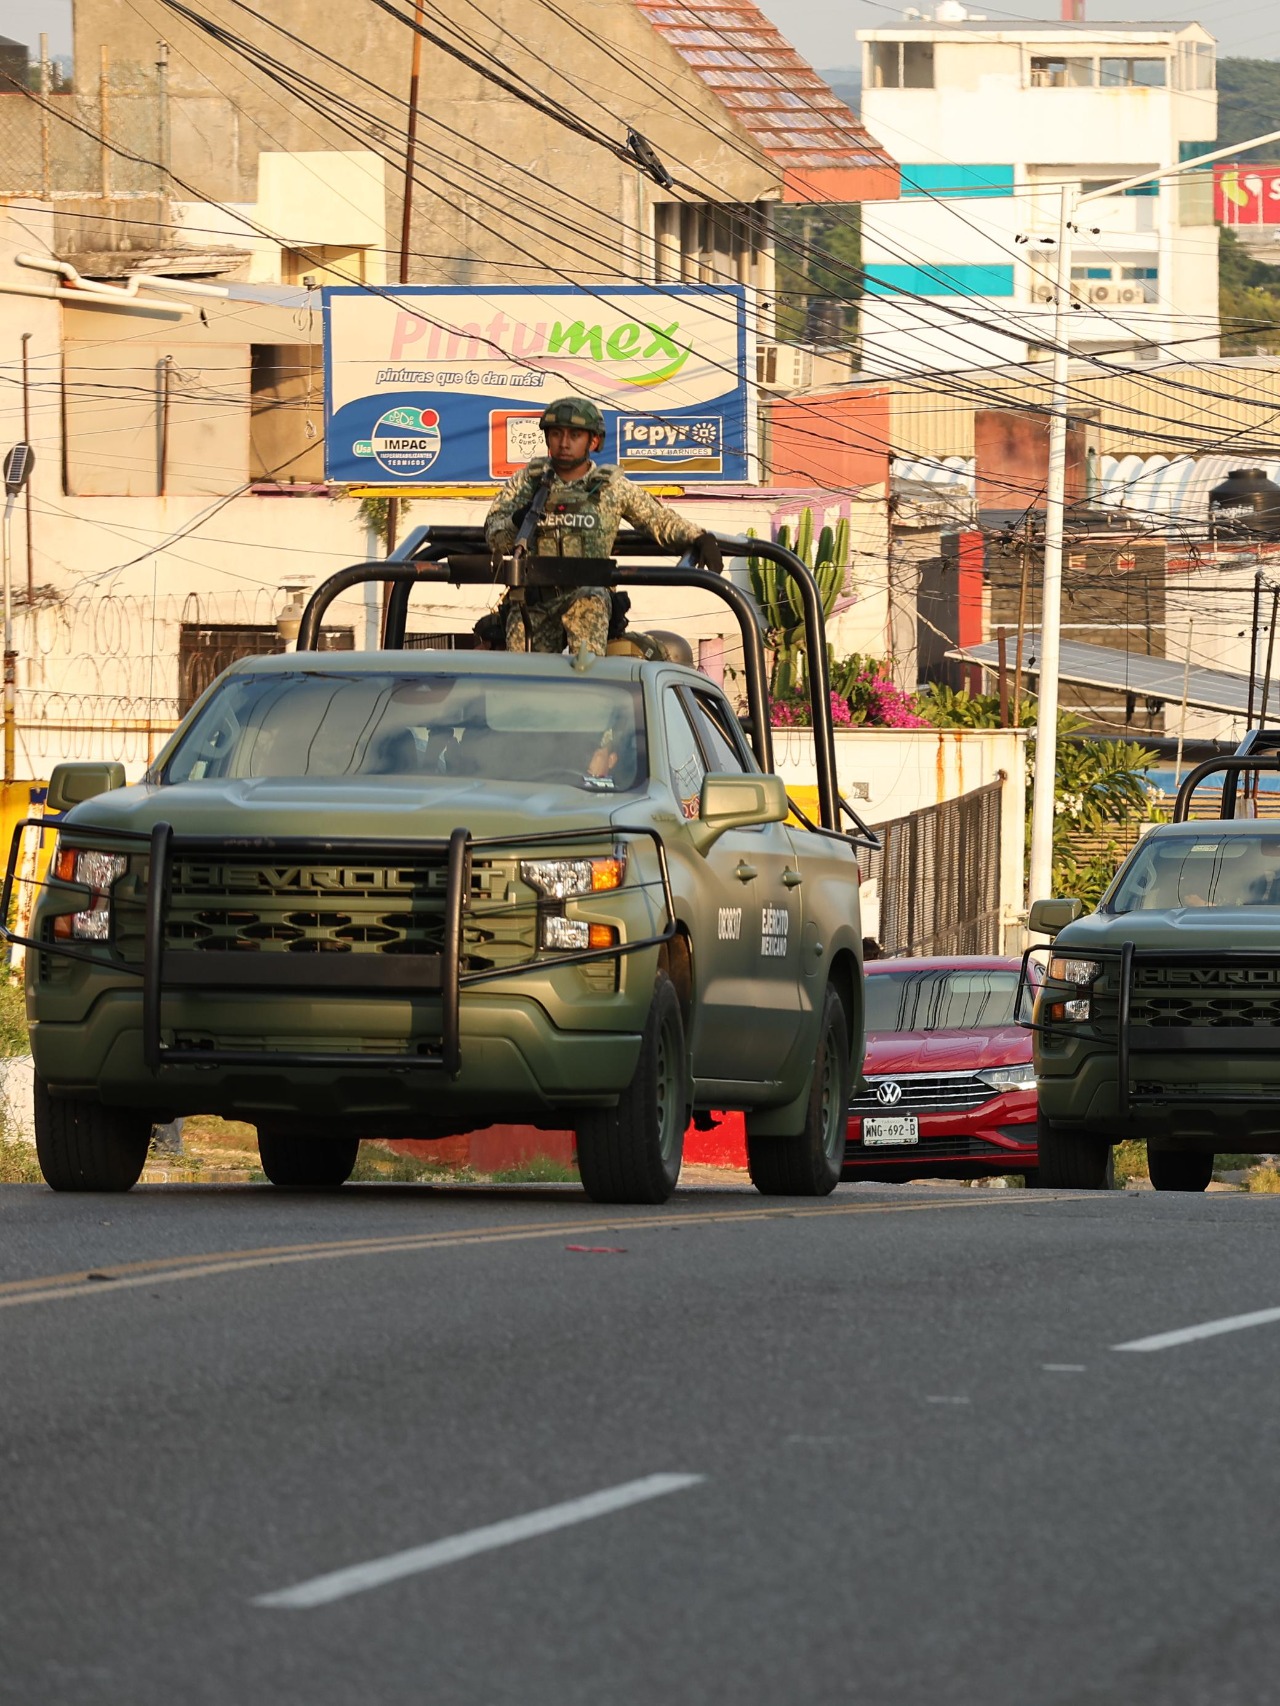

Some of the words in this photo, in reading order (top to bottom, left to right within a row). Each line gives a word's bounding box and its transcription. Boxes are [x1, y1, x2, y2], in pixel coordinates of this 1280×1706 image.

[389, 309, 684, 362] Pintumex
[376, 368, 435, 385] pinturas
[436, 372, 462, 386] que
[464, 368, 478, 385] te
[482, 371, 507, 386] dan
[510, 371, 545, 387] más!
[356, 445, 372, 454] Usa
[385, 440, 427, 450] IMPAC
[537, 512, 595, 528] JERCITO
[146, 865, 504, 890] HEVROLET
[865, 1123, 916, 1138] WNG-692-B
